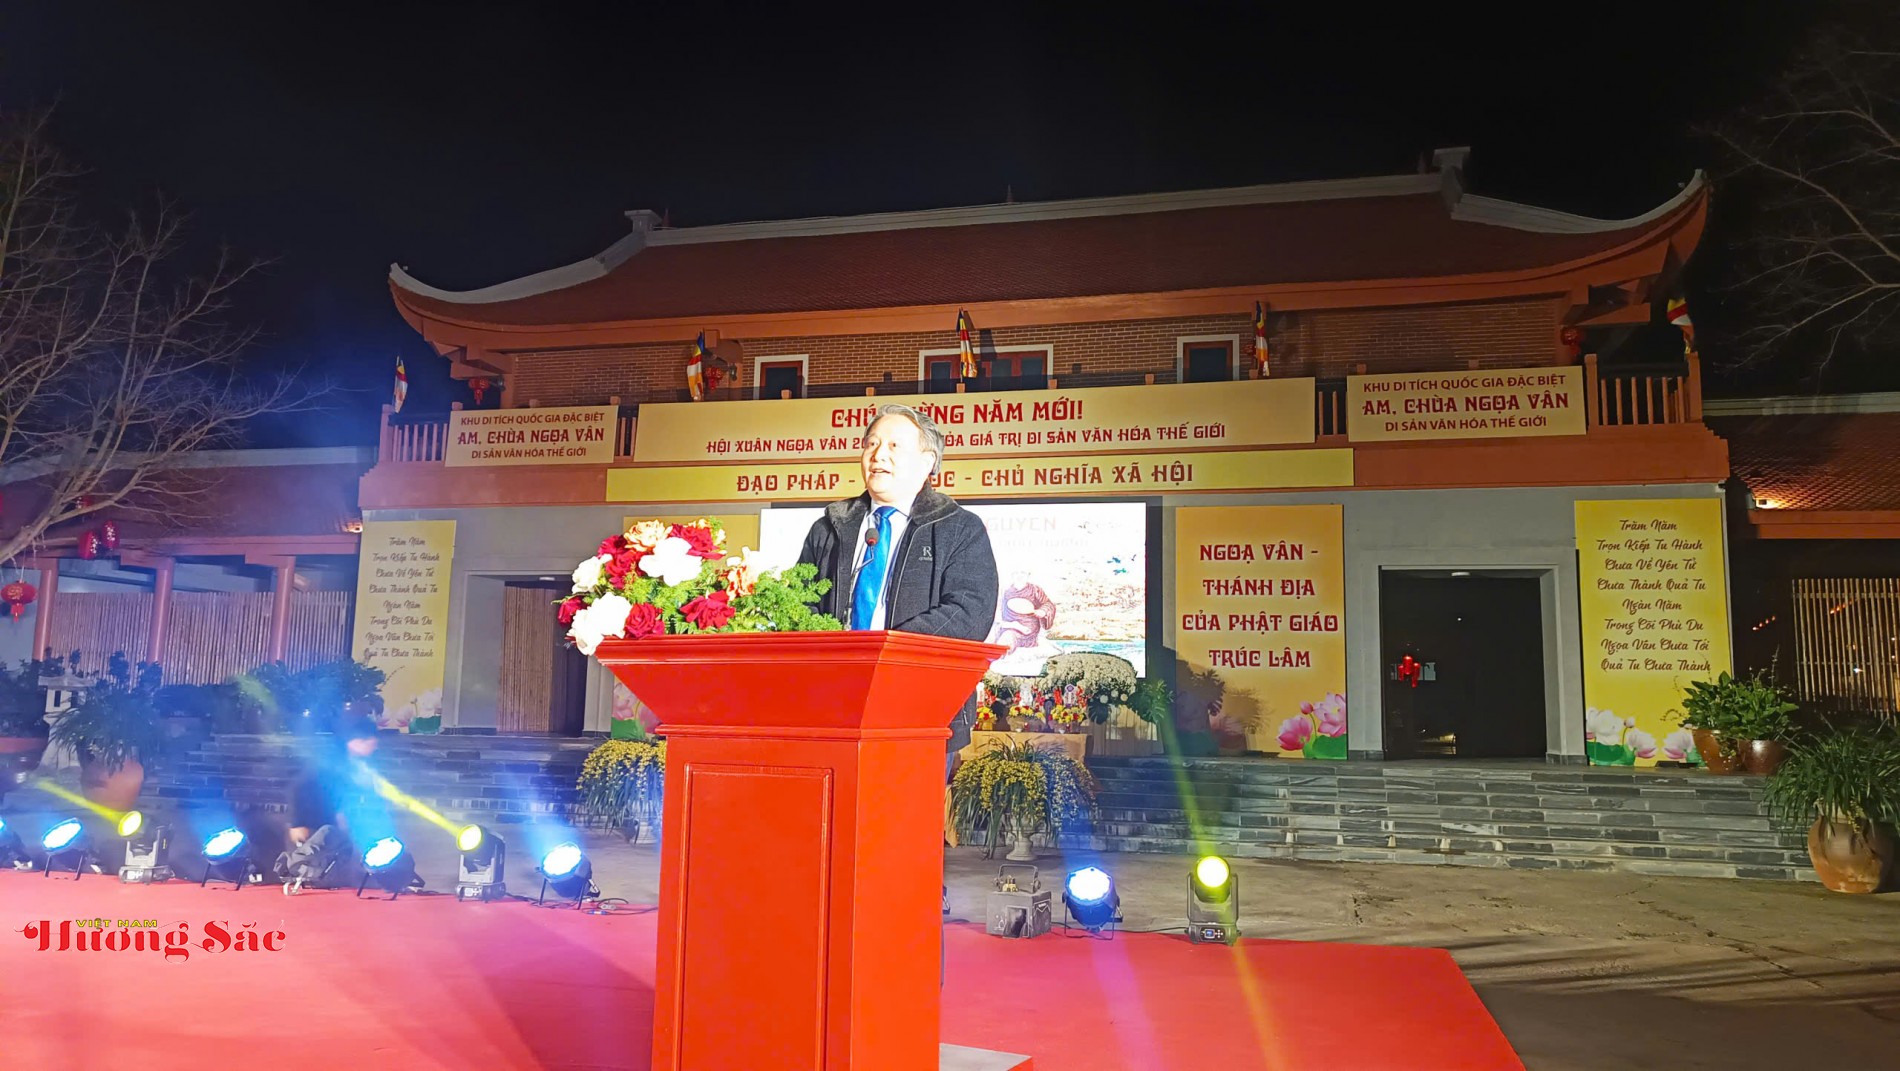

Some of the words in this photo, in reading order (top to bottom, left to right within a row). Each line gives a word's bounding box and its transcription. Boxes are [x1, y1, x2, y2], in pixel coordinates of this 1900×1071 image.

[1363, 383, 1390, 392] KHU
[1394, 381, 1406, 391] DI
[1410, 376, 1438, 390] TÍCH
[1441, 377, 1478, 390] QUỐC
[1481, 378, 1504, 388] GIA
[1507, 376, 1534, 389] ĐẶC
[1538, 374, 1566, 387] BIỆT
[1362, 400, 1397, 416] AM.
[1404, 394, 1458, 414] CHÙA
[1465, 395, 1520, 414] NGỌA
[1527, 390, 1569, 410] VÂN
[460, 417, 479, 425] KHU
[493, 413, 513, 424] TÍCH
[514, 413, 543, 424] QUỐC
[545, 415, 561, 423] GIA
[563, 412, 582, 424] ĐẶC
[585, 412, 604, 423] BIỆT
[831, 403, 877, 428] CHÚ
[912, 401, 964, 424] ỪNG
[973, 398, 1023, 424] NĂM
[1032, 396, 1083, 421] MỚI!
[1385, 422, 1398, 431] DI
[1402, 418, 1428, 430] SẢN
[1429, 418, 1456, 430] VĂN
[1460, 417, 1488, 429] HÓA
[1490, 414, 1516, 428] THẾ
[1518, 416, 1547, 427] GIỚI
[458, 431, 482, 445] AM.
[487, 428, 525, 444] CHÙA
[531, 429, 569, 445] NGỌA
[575, 425, 604, 441] VÂN
[706, 439, 731, 455] HỘI
[735, 438, 772, 452] XUÂN
[777, 439, 814, 454] NGỌA
[820, 436, 847, 450] VÂN
[942, 431, 965, 447] ỎA
[970, 431, 993, 446] GIÁ
[999, 433, 1021, 447] TRỊ
[1027, 432, 1041, 444] DI
[1047, 428, 1076, 443] SẢN
[1082, 427, 1112, 442] VĂN
[1118, 425, 1151, 441] HÓA
[1157, 422, 1189, 439] THẾ
[1194, 422, 1225, 438] GIỚI
[483, 450, 502, 458] SẢN
[524, 449, 544, 457] HÓA
[547, 446, 565, 457] THẾ
[566, 448, 587, 456] GIỚI
[737, 475, 778, 495] ĐẠO
[787, 470, 840, 491] PHÁP
[982, 464, 1024, 486] CHỦ
[1034, 463, 1102, 485] NGHĨA
[1112, 462, 1142, 483] XÃ
[1151, 461, 1193, 486] HỘI
[1200, 544, 1255, 564] NGOẠ
[1262, 540, 1303, 560] VÂN
[1596, 539, 1620, 553] Trọn
[1625, 538, 1650, 553] Kiếp
[1655, 539, 1668, 550] Tu
[1672, 539, 1703, 550] Hành
[1605, 558, 1632, 570] Chưa
[1655, 559, 1678, 572] Yên
[1202, 576, 1273, 596] THÁNH
[1280, 579, 1315, 599] ĐỊA
[1597, 578, 1625, 590] Chưa
[1629, 578, 1663, 590] Thành
[1666, 578, 1688, 592] Quả
[1692, 579, 1706, 590] Tu
[1622, 599, 1652, 615] Ngàn
[1655, 599, 1682, 612] Năm
[1182, 610, 1221, 630] CỦA
[1228, 611, 1282, 635] PHẬT
[1289, 611, 1338, 632] GIÁO
[1604, 619, 1635, 635] Trong
[1638, 618, 1656, 630] Cõi
[1659, 619, 1682, 630] Phù
[1686, 619, 1703, 630] Du
[1632, 639, 1656, 650] Vân
[1660, 638, 1689, 650] Chưa
[1209, 647, 1261, 668] TRÚC
[1269, 647, 1311, 668] LÂM
[1601, 658, 1624, 672] Quả
[1627, 659, 1640, 670] Tu
[1645, 658, 1672, 670] Chưa
[1678, 659, 1710, 670] Thành
